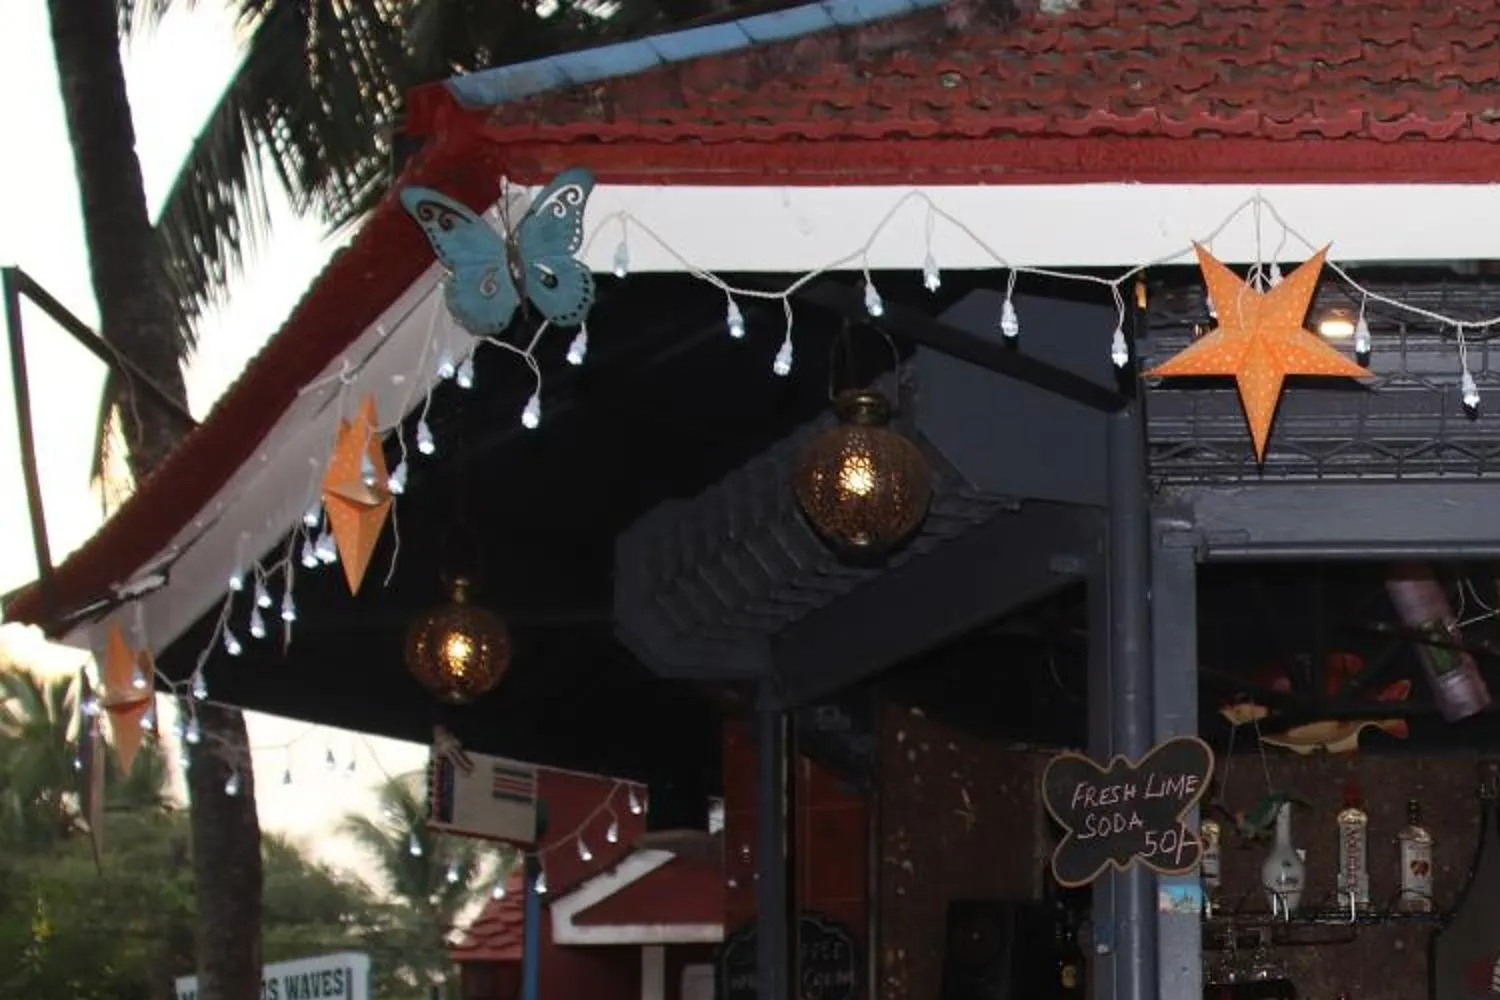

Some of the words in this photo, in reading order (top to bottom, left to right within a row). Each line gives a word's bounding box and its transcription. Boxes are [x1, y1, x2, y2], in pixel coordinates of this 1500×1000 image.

[1071, 781, 1136, 810] FRESH
[1144, 773, 1200, 800] LIME
[1077, 812, 1143, 840] SODA
